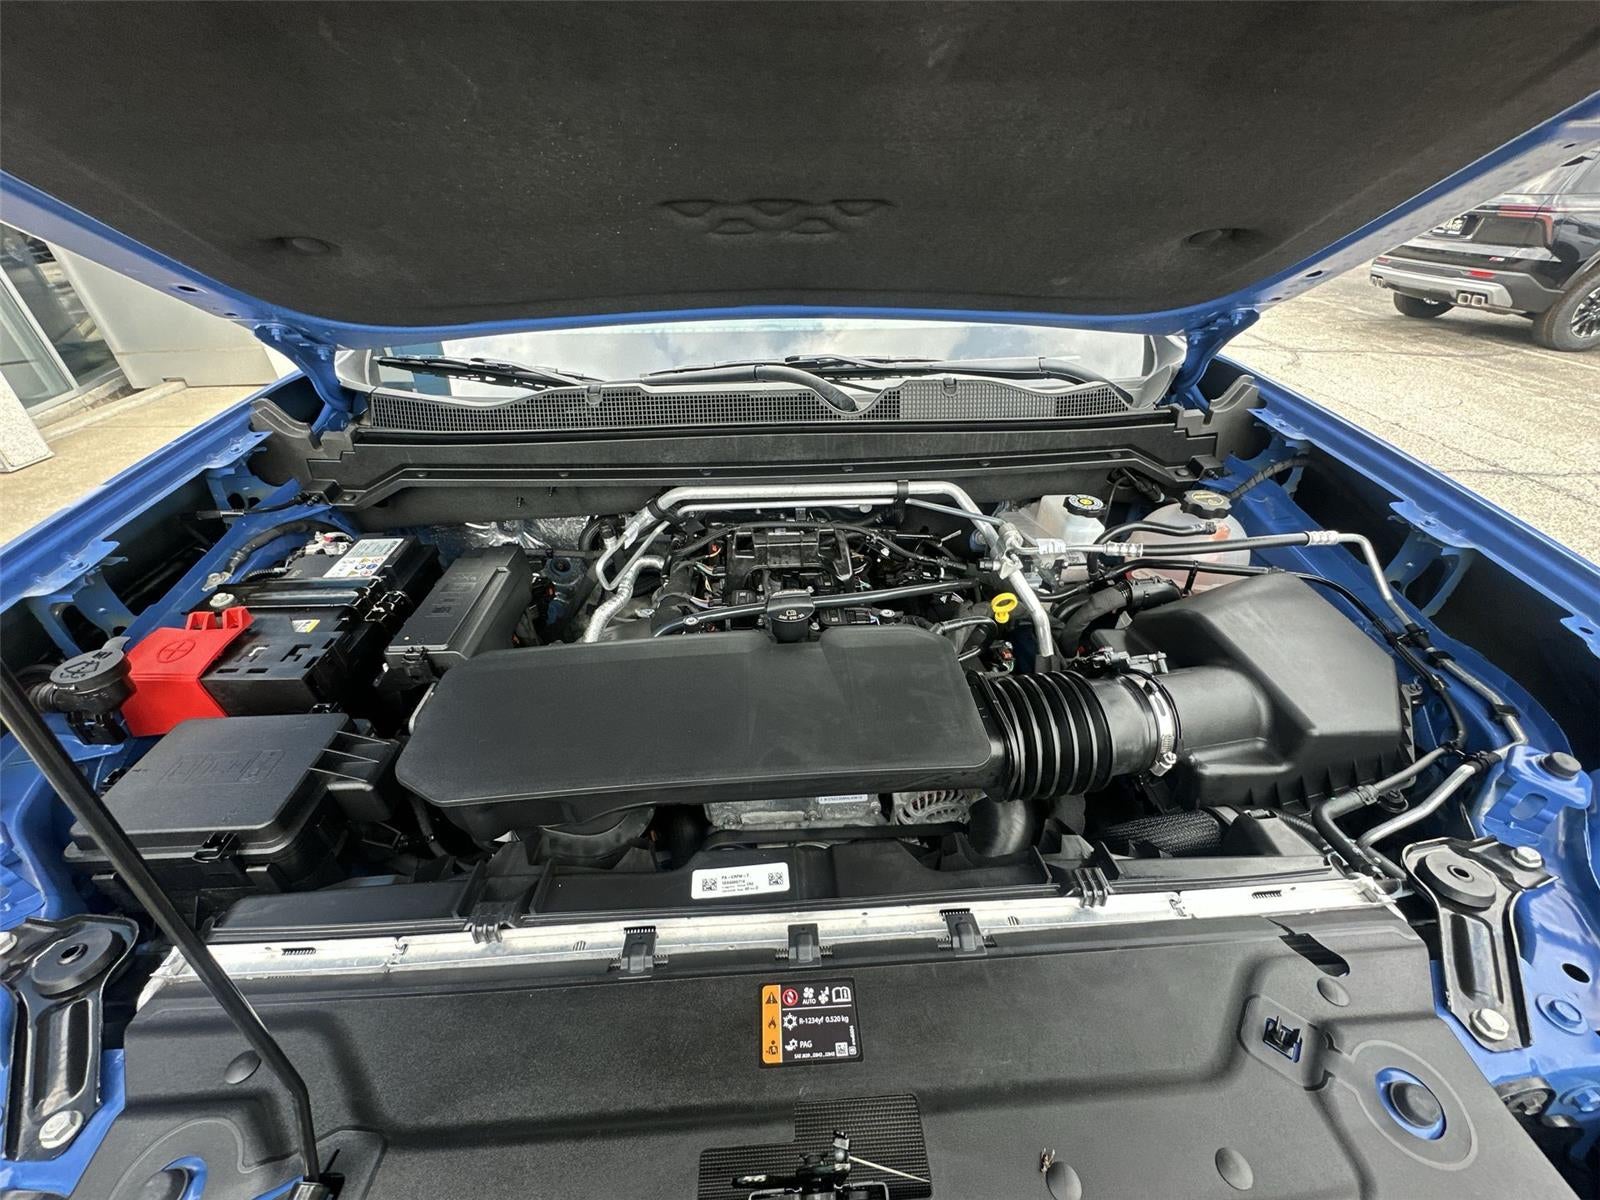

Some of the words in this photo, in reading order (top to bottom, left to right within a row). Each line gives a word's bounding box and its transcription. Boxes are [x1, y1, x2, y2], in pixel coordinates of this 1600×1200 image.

[798, 1016, 824, 1025] R-1234yf
[825, 1015, 841, 1023] 0.520
[841, 1015, 849, 1024] kg
[799, 1040, 813, 1048] PAG
